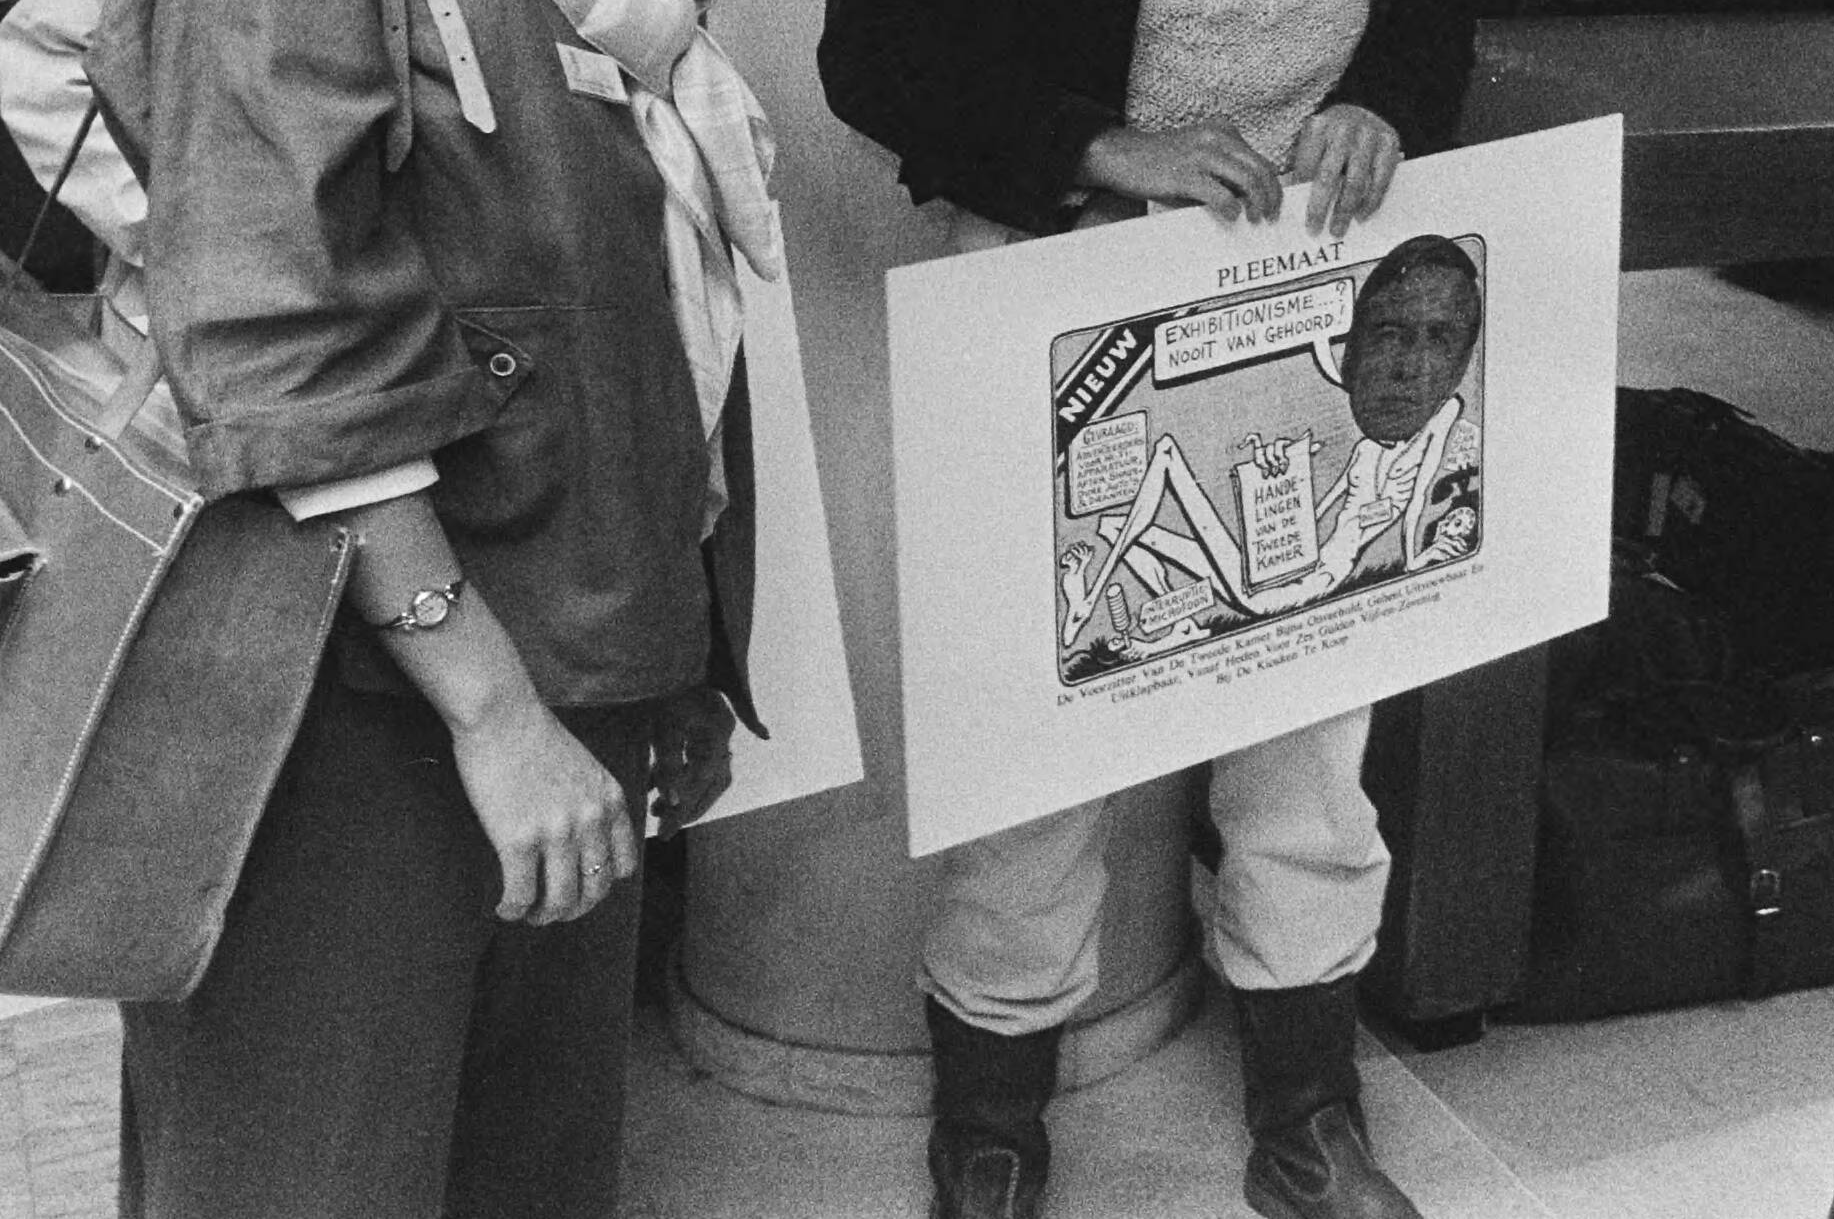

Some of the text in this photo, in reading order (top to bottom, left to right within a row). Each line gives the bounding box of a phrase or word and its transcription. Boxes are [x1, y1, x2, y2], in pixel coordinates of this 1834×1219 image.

[1217, 242, 1343, 287] PLEEMAAT
[1168, 341, 1217, 368] NOOIT
[1227, 334, 1257, 352] VAN
[1058, 328, 1139, 423] NIEUW
[1254, 476, 1304, 505] HANDE-
[1255, 495, 1302, 523] LINGEN
[1281, 515, 1296, 528] DE
[1256, 543, 1304, 571] KAMER
[1303, 644, 1316, 655] Te
[1057, 694, 1073, 707] De
